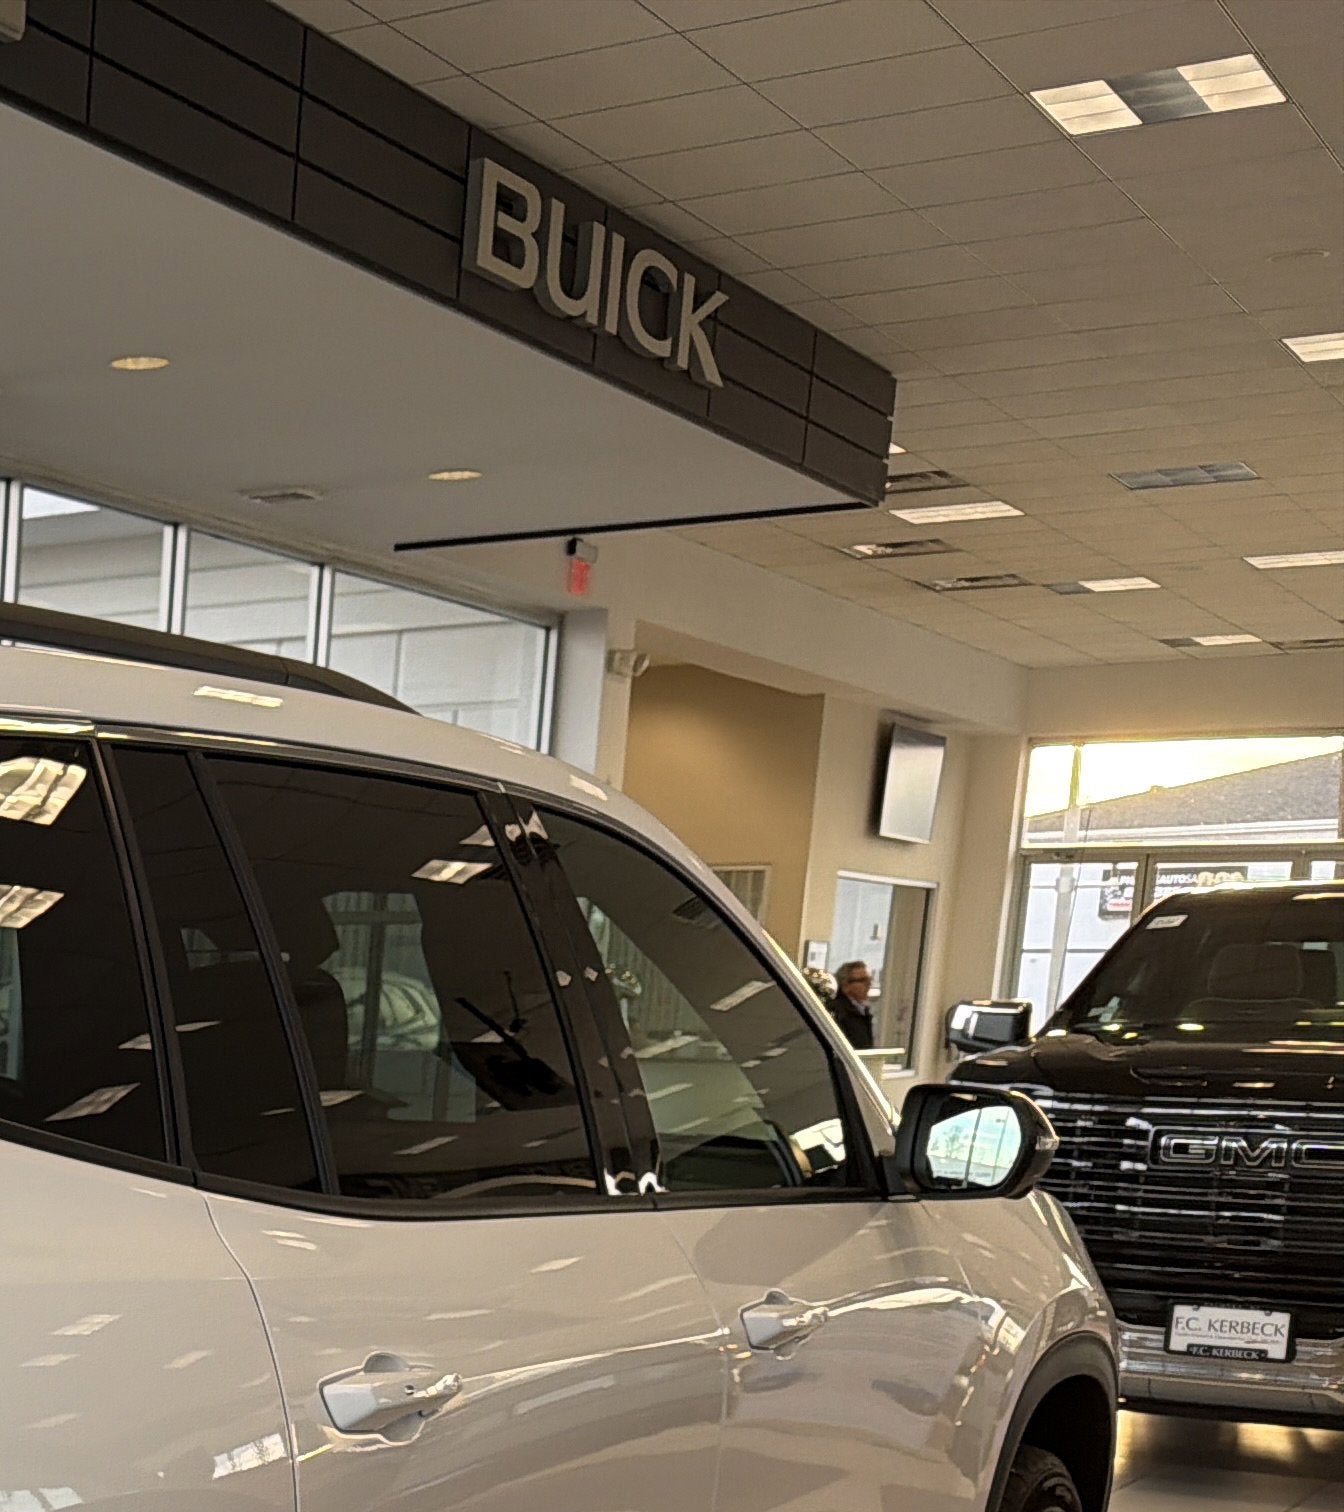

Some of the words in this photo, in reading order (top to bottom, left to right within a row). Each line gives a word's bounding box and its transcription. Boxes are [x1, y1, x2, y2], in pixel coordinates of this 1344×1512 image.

[467, 157, 730, 387] BUICK
[1161, 1134, 1344, 1169] GMC
[1175, 1317, 1202, 1332] F.C.
[1208, 1318, 1286, 1338] KERBECK
